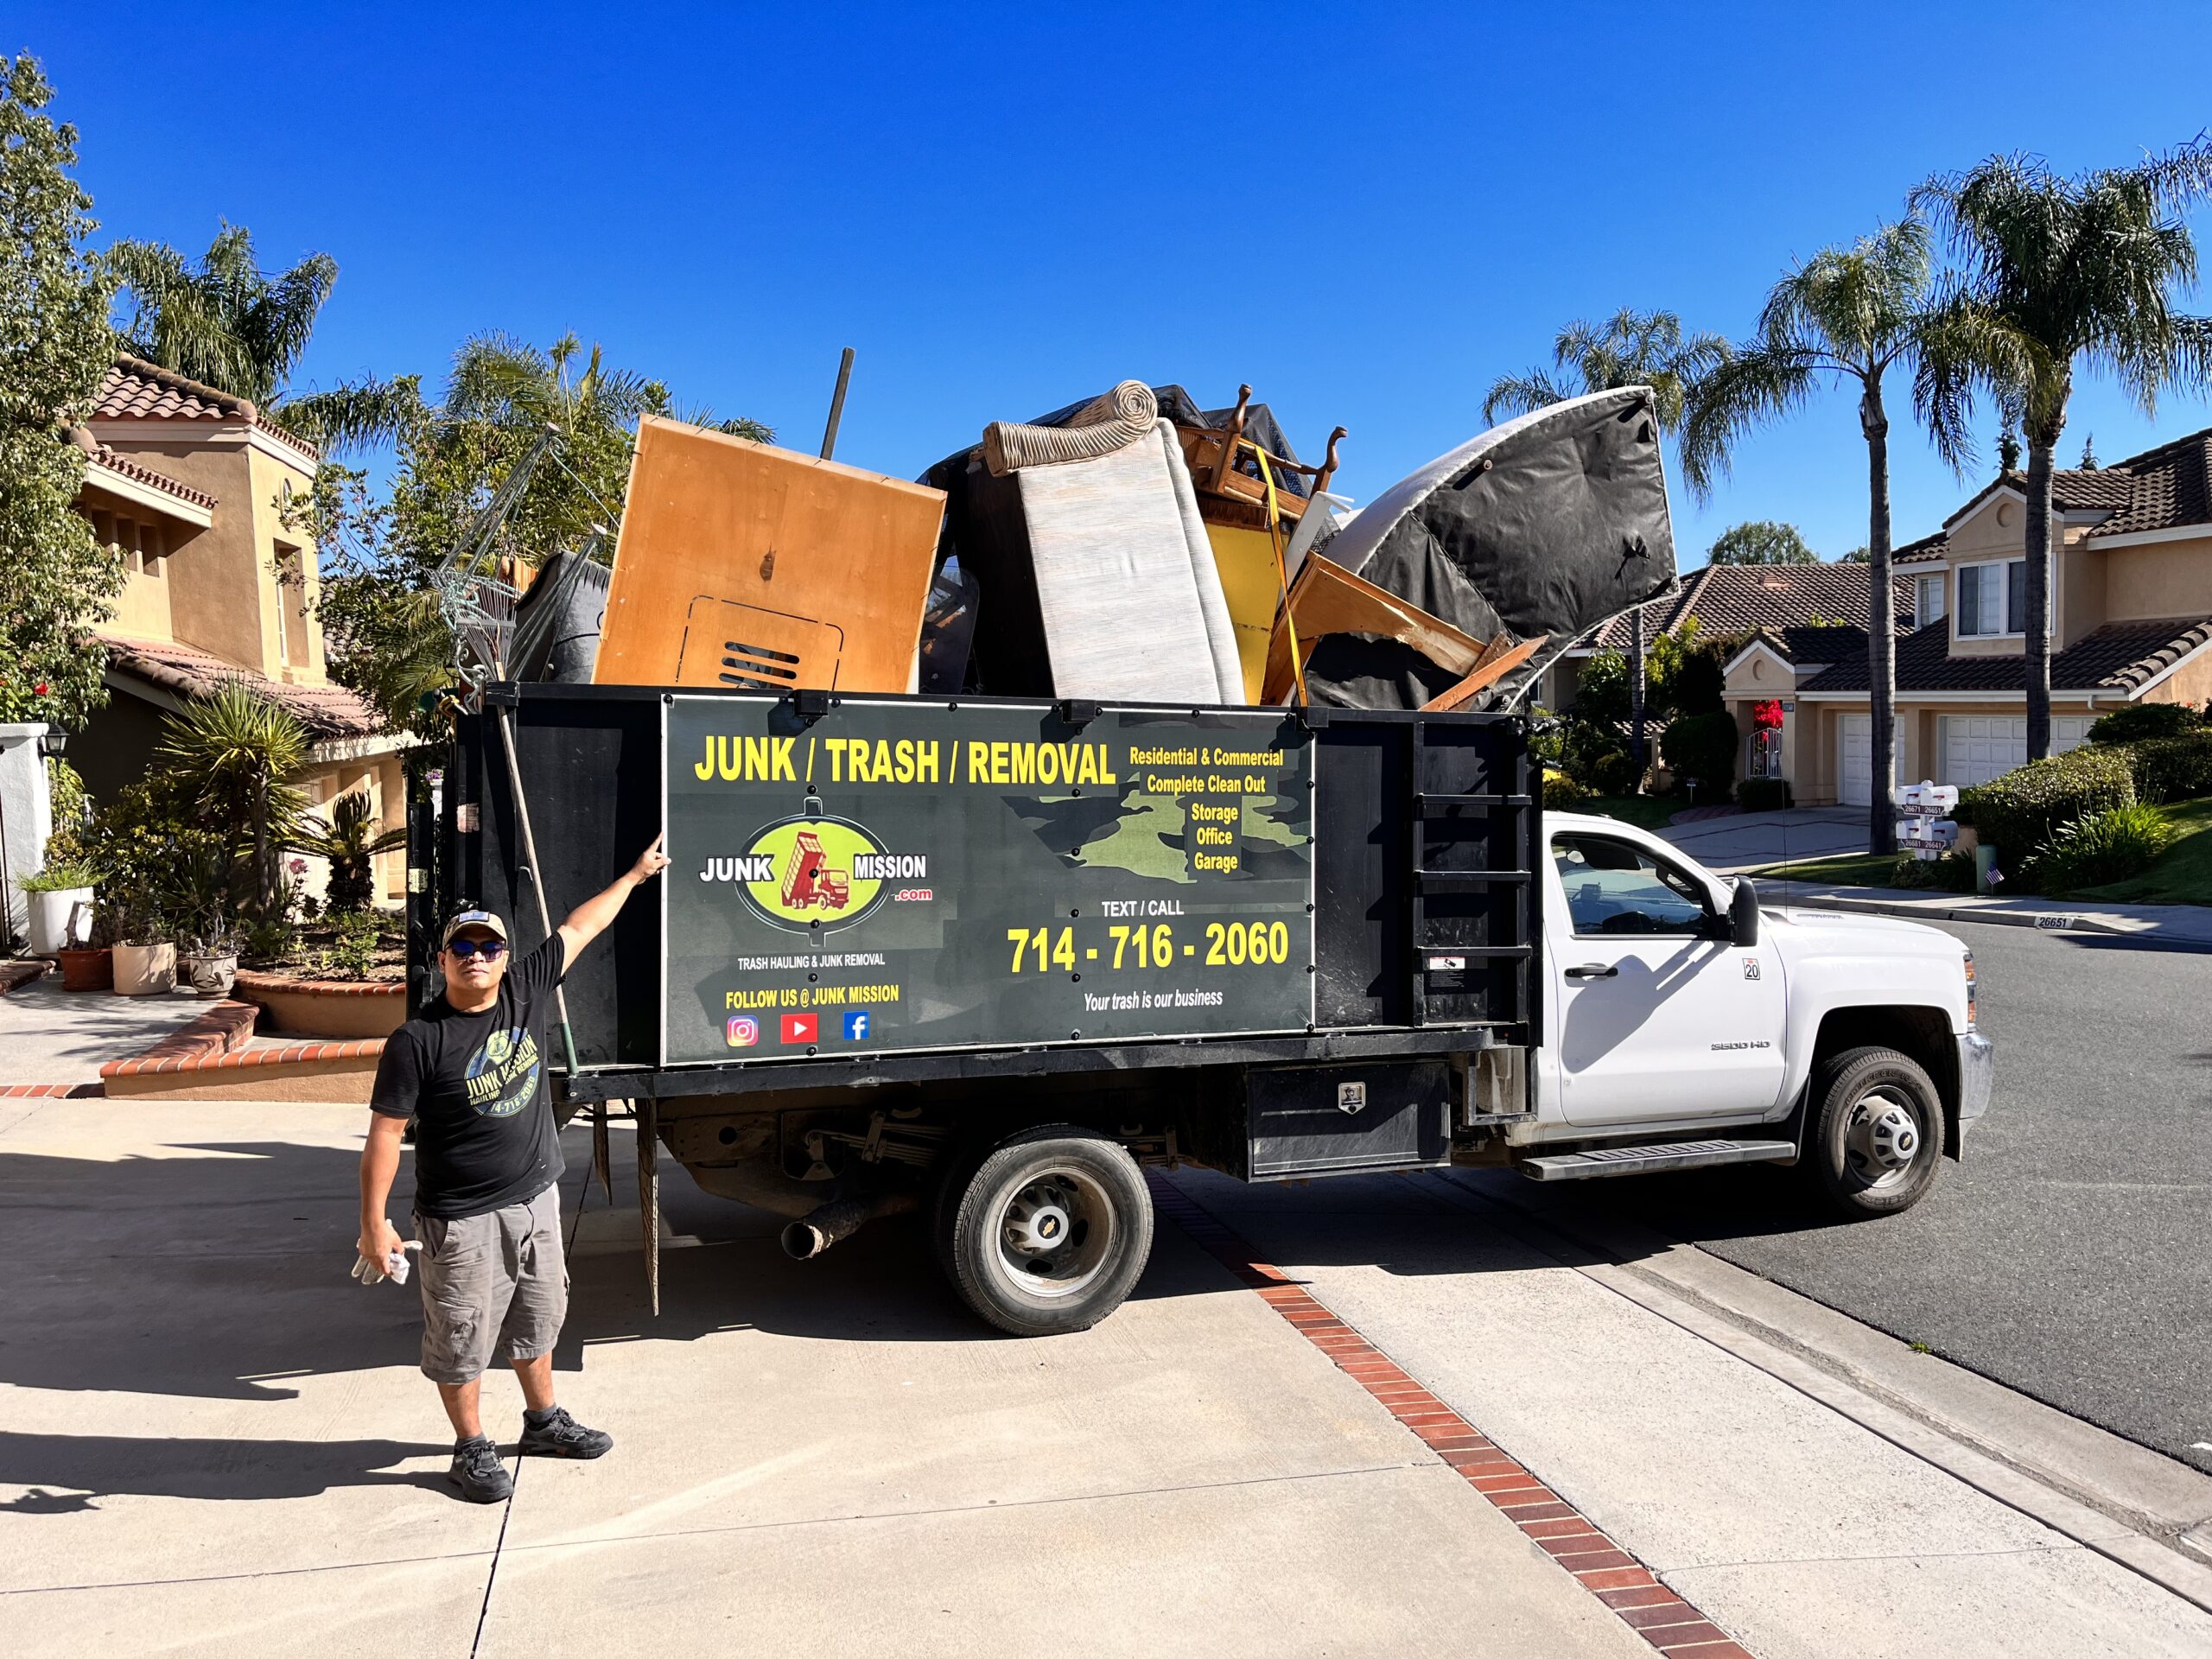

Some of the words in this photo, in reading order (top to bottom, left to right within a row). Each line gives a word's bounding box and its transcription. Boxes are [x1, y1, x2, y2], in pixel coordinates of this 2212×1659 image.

[695, 736, 797, 781] JUNK
[825, 739, 938, 783] TRASH
[969, 741, 1116, 784] REMOVAL
[1130, 747, 1197, 765] Residential
[1201, 748, 1210, 765] &
[1214, 748, 1283, 766] Commercial
[1147, 775, 1205, 796] Complete
[1208, 775, 1241, 792] Clean
[1245, 775, 1265, 792] Out
[1192, 804, 1238, 824] Storage
[1197, 827, 1232, 844] Office
[699, 855, 773, 881] JUNK
[854, 855, 926, 880] MISSION
[1195, 853, 1237, 873] Garage
[894, 888, 932, 900] .com
[1102, 901, 1137, 917] TEXT
[1148, 900, 1184, 916] CALL
[2038, 918, 2067, 927] 26651
[1007, 927, 1075, 972] 714
[1109, 925, 1173, 969] 716
[1206, 922, 1288, 965] 2060
[738, 957, 768, 970] TRASH
[771, 956, 809, 969] HAULING
[811, 956, 817, 967] &
[820, 955, 842, 967] JUNK
[845, 953, 885, 966] REMOVAL
[1746, 965, 1758, 977] 20
[727, 990, 777, 1008] FOLLOW
[781, 989, 798, 1007] US
[813, 988, 845, 1005] JUNK
[849, 985, 899, 1002] MISSION
[1084, 993, 1110, 1011] Your
[1112, 991, 1139, 1009] trash
[1142, 990, 1152, 1008] is
[1154, 994, 1173, 1007] our
[1175, 988, 1223, 1007] business
[467, 1070, 503, 1099] JUNK
